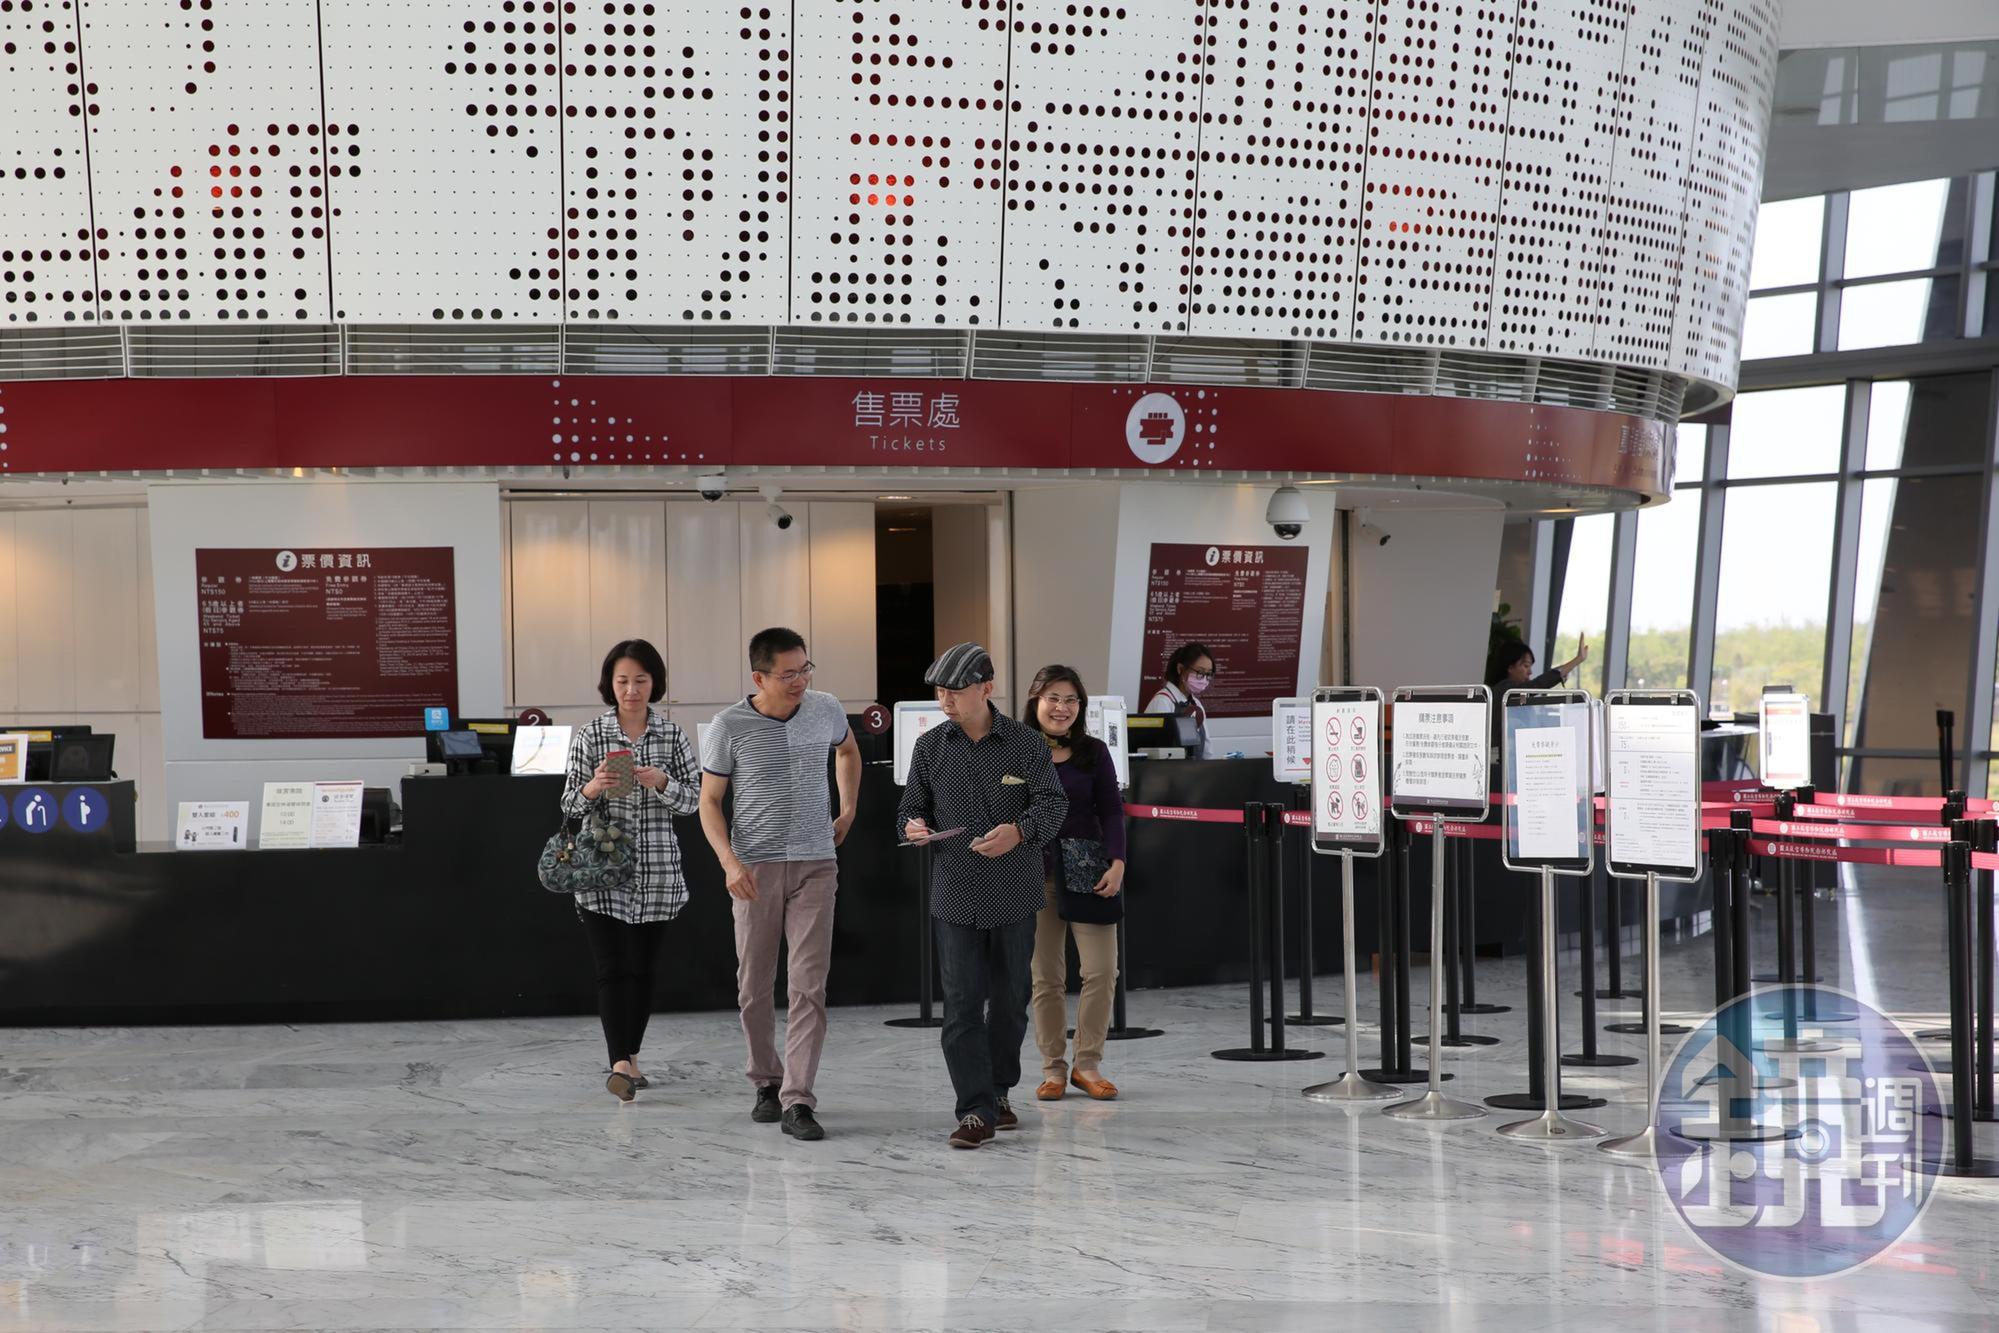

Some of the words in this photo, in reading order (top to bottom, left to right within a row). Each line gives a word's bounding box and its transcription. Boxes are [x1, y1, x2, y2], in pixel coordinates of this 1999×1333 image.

[851, 391, 960, 428] 售票處
[870, 435, 946, 451] Tickets
[301, 553, 372, 569] 票價資訊
[1221, 550, 1265, 564] 票價資訊
[527, 713, 540, 726] 2
[871, 711, 883, 728] 3
[1286, 715, 1296, 765] 請在此稍候
